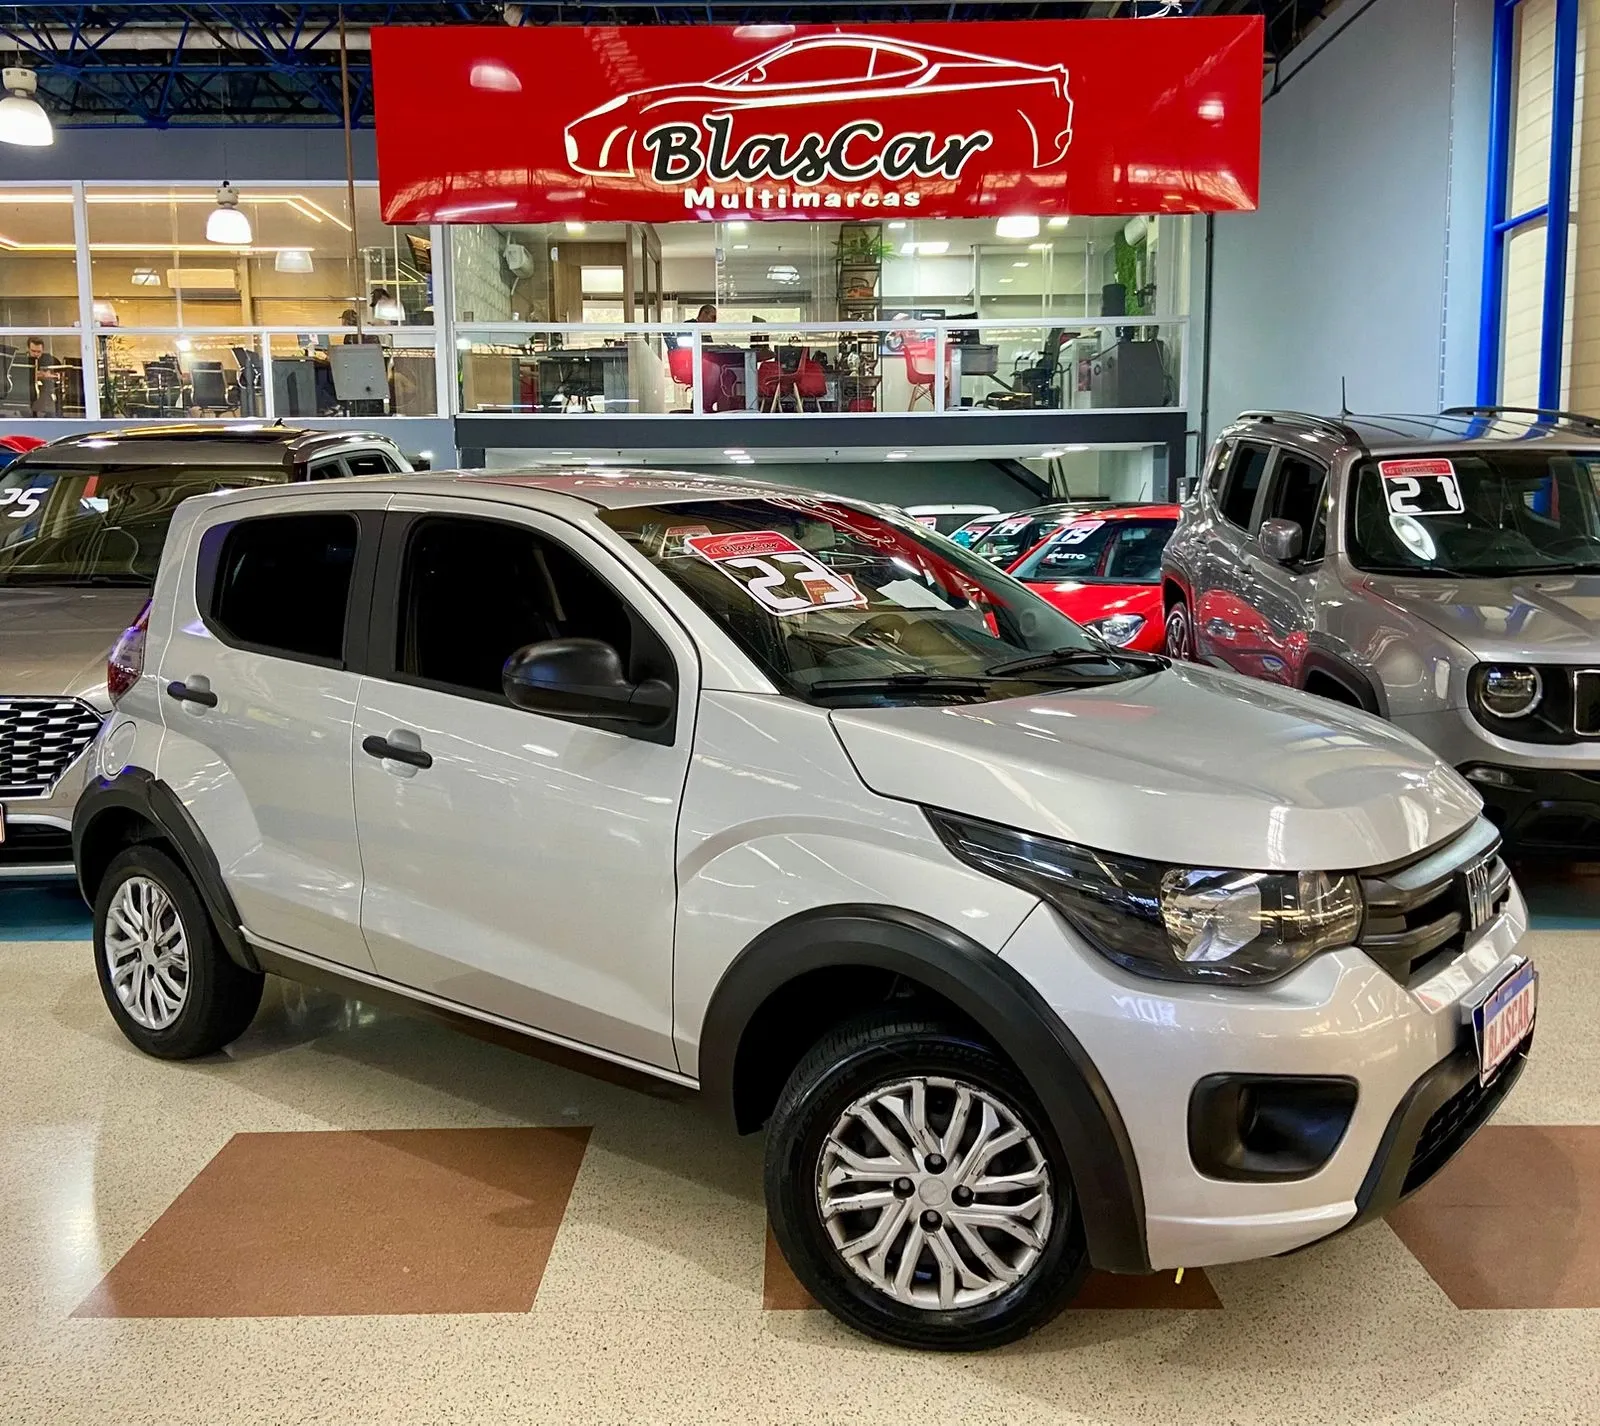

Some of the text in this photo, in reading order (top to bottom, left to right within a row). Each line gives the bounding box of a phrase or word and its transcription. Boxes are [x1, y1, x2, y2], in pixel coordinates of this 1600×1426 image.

[643, 113, 994, 184] BlasCar
[684, 186, 921, 210] Multimarcas
[1389, 475, 1460, 513] 21
[723, 553, 857, 611] 23
[1487, 988, 1530, 1066] BLASCAR
